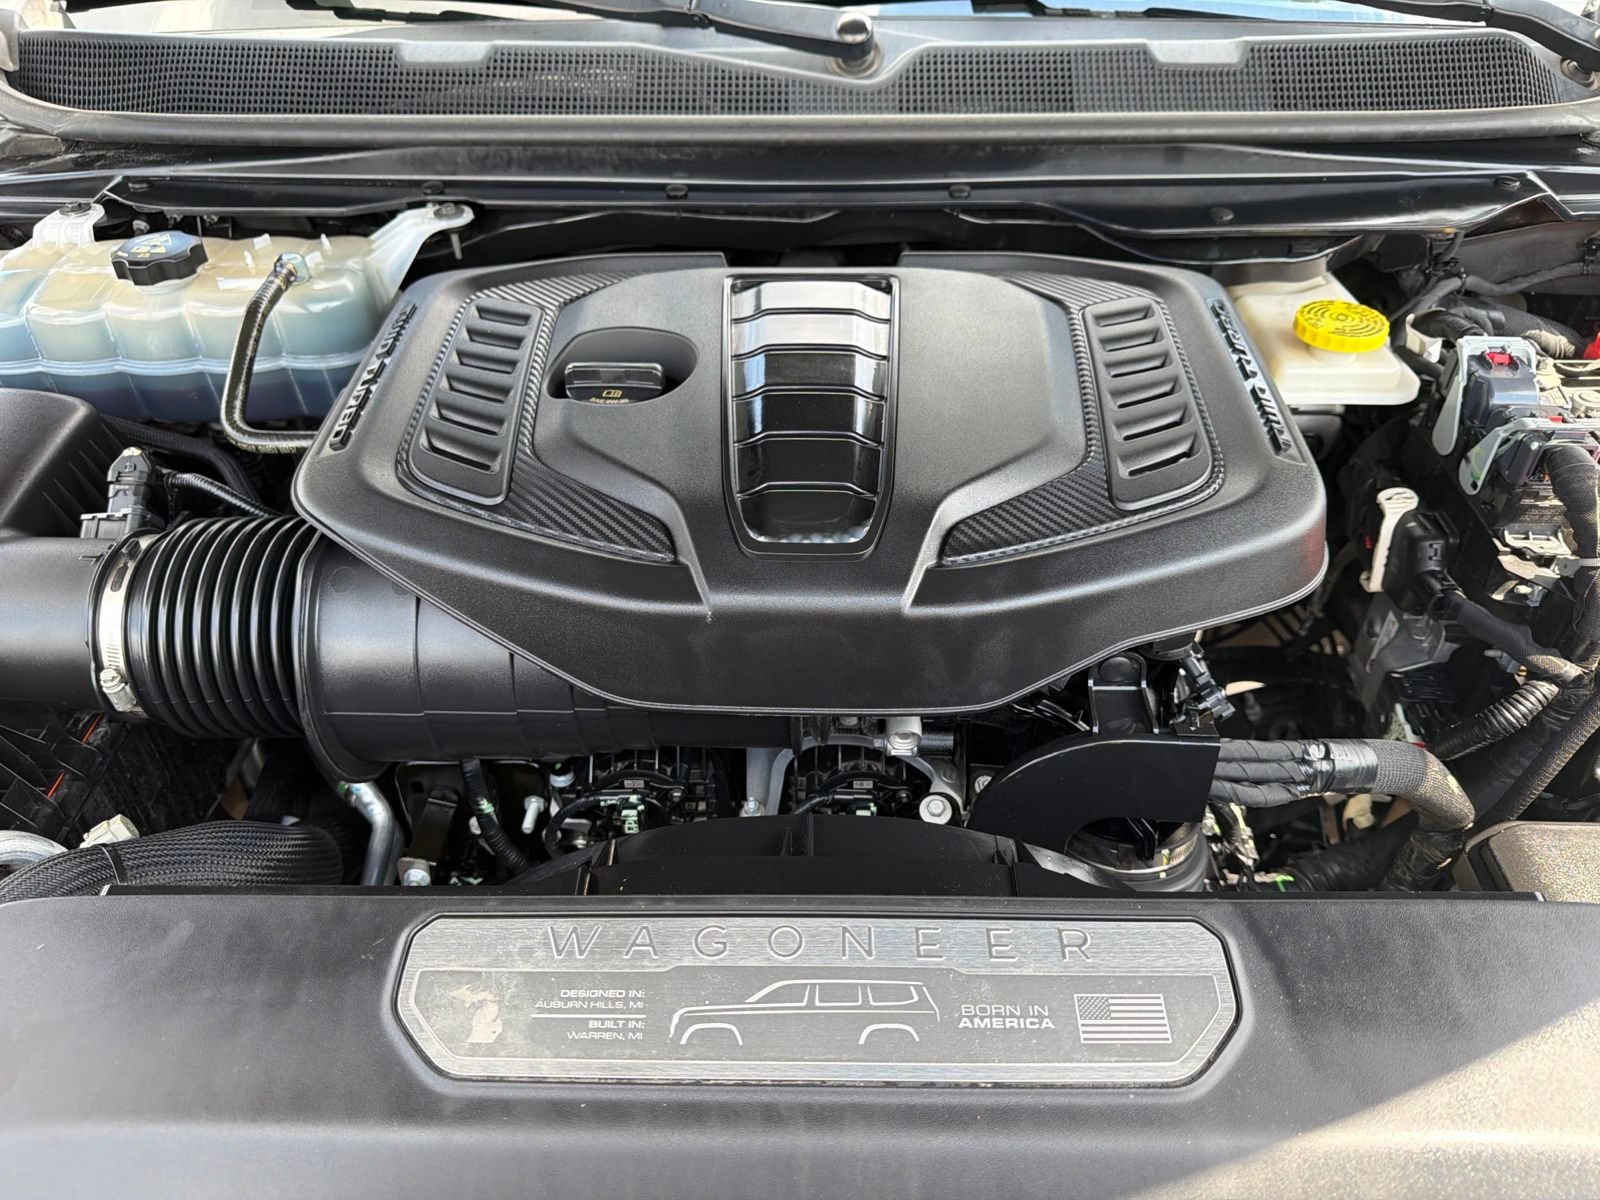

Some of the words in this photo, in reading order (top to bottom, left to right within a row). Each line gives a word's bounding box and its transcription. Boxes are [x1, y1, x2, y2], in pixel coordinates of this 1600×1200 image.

[1210, 301, 1259, 381] TURBO
[329, 359, 387, 452] TURBO
[546, 923, 1094, 961] WAGONEER
[560, 989, 626, 998] DESIGNED
[628, 989, 646, 998] IN:
[535, 1000, 588, 1009] AUBURN
[590, 1000, 626, 1010] HILLS,
[629, 1001, 644, 1009] MI
[961, 1004, 1021, 1017] BORN
[1029, 1004, 1049, 1017] IN
[588, 1020, 626, 1029] BUILT
[627, 1020, 646, 1029] IN:
[958, 1017, 1056, 1030] AMERICA
[567, 1031, 626, 1041] WARREN,
[628, 1032, 643, 1040] MI
